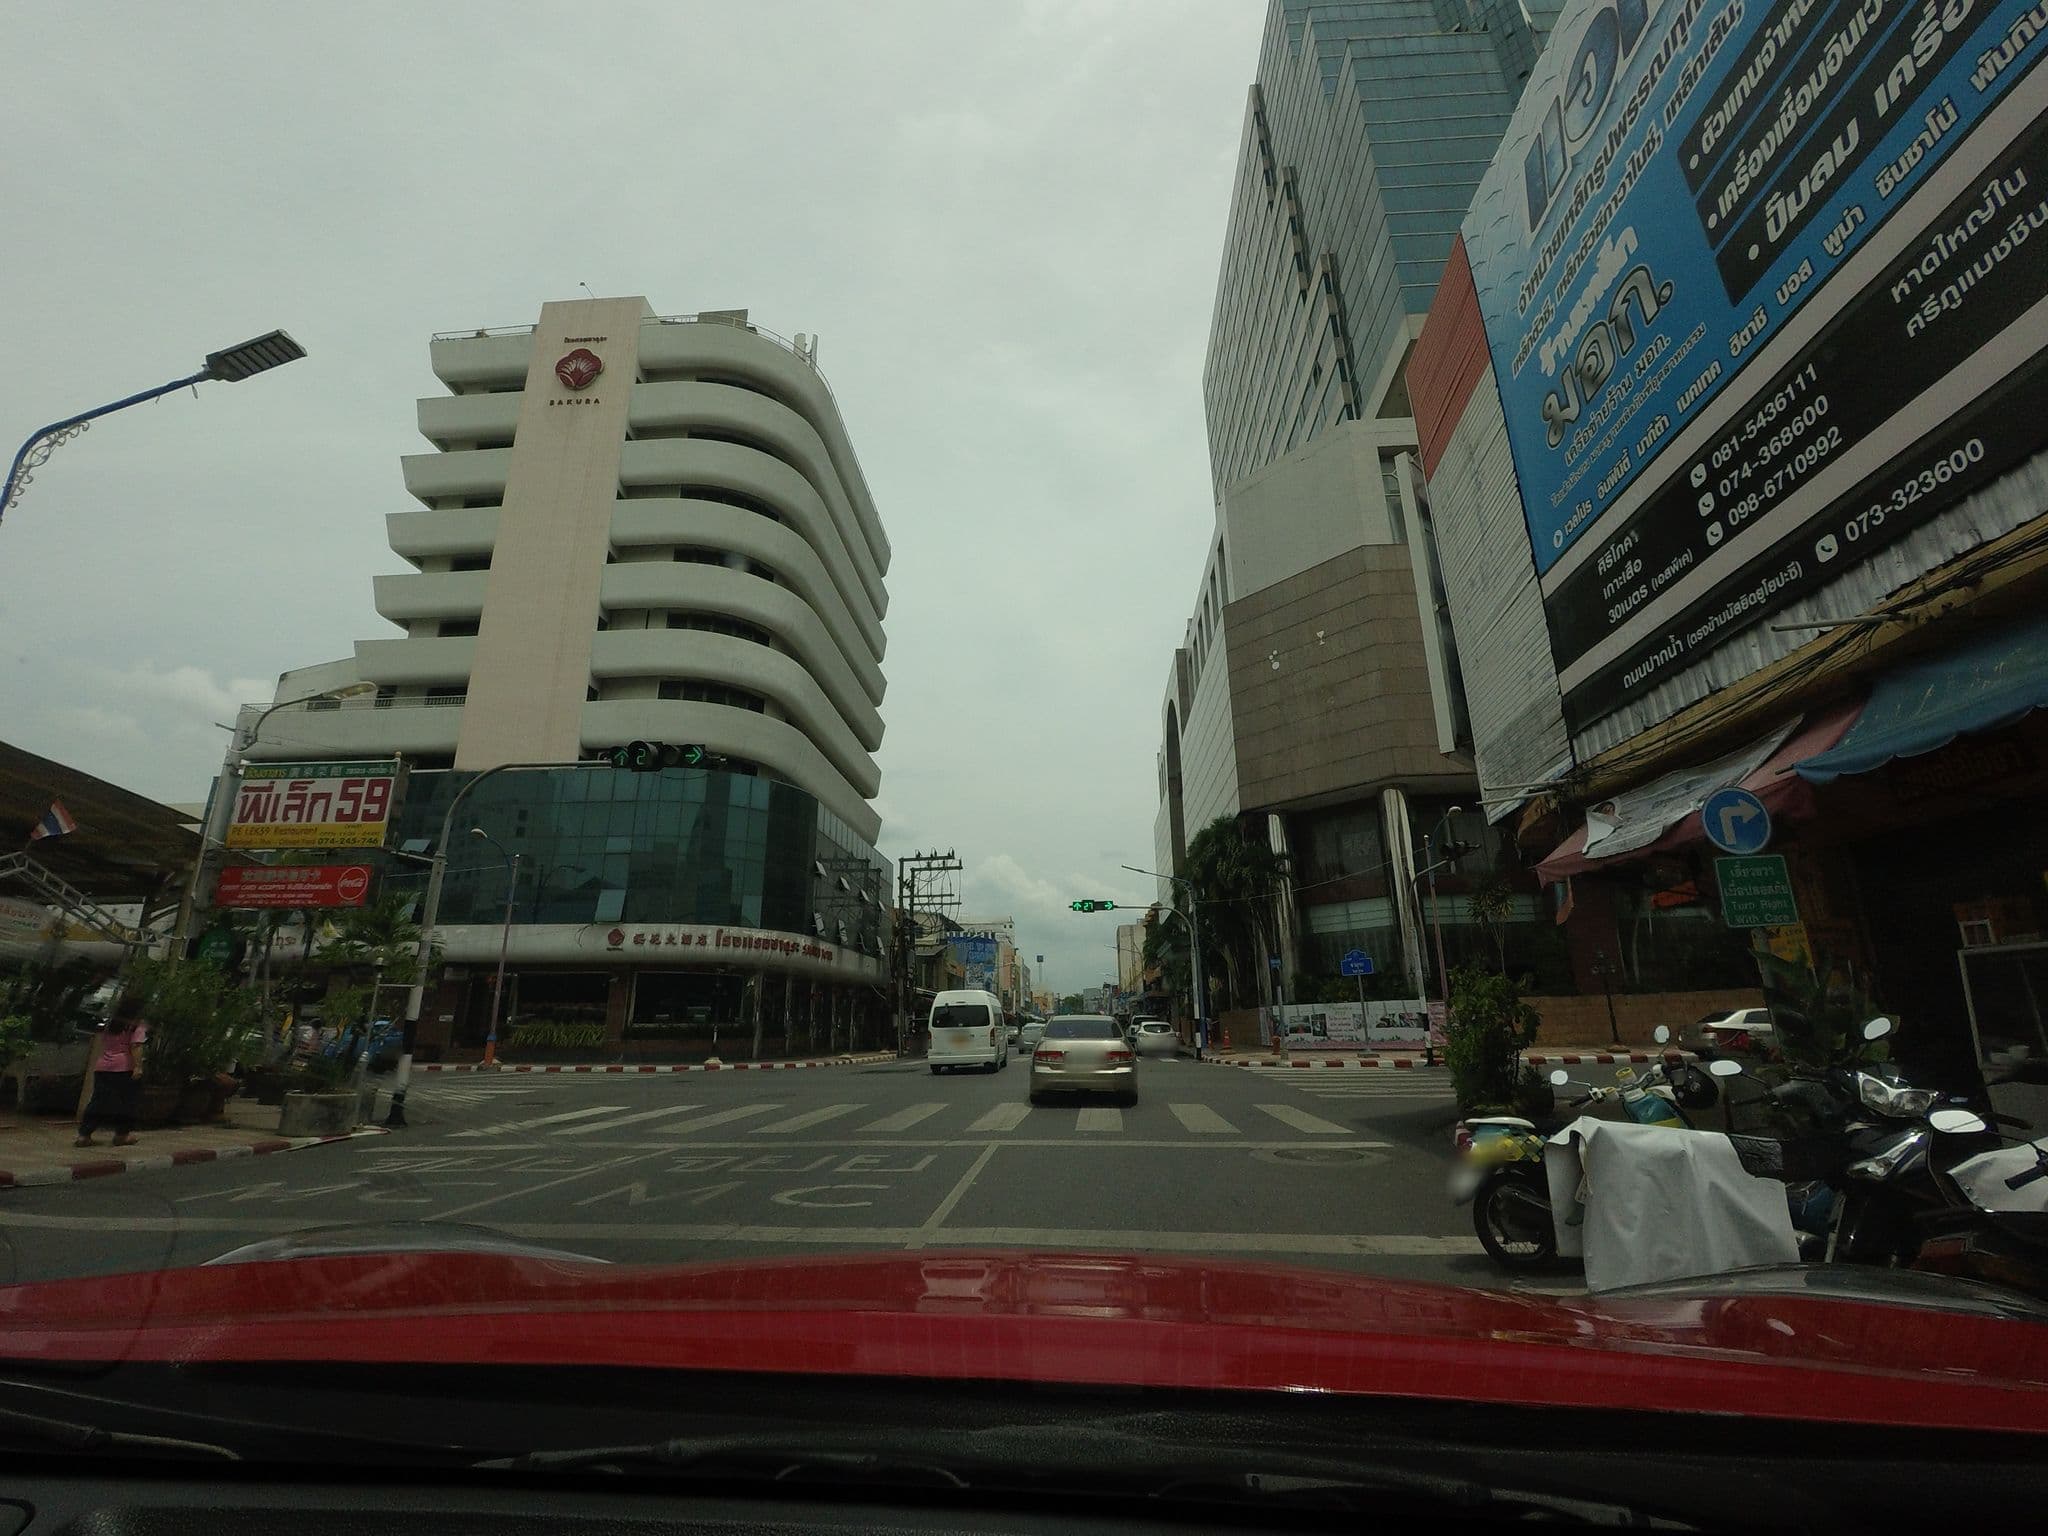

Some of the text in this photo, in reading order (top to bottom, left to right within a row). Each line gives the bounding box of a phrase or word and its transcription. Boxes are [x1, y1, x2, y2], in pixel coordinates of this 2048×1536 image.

[1712, 363, 1817, 470] 081-5436111
[1720, 395, 1829, 497] 074-368600
[1728, 426, 1843, 526] 098-6710992
[1844, 438, 1985, 542] 073-323600
[335, 778, 392, 823] 59
